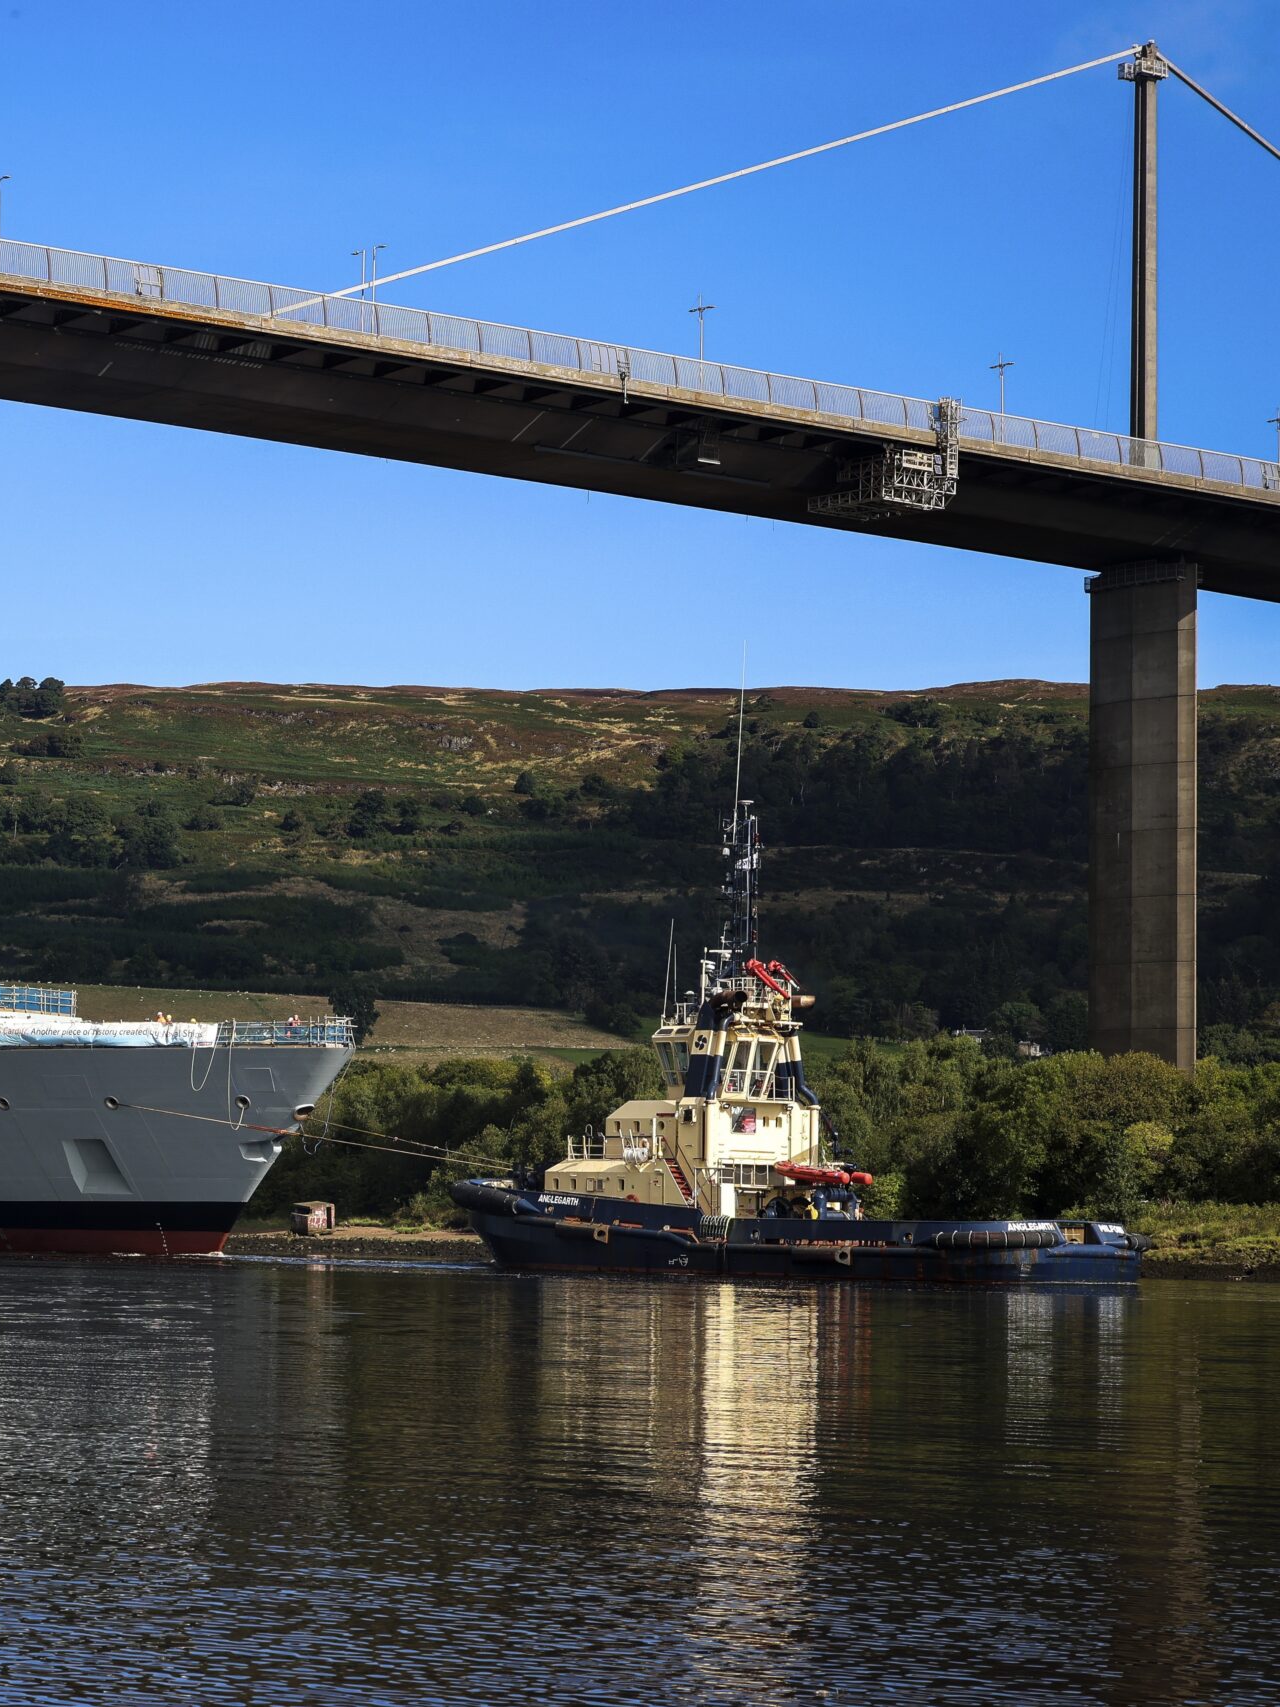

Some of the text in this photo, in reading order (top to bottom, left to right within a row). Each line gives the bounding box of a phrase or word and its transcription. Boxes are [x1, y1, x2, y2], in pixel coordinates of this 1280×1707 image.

[31, 1027, 60, 1036] Another
[61, 1028, 81, 1038] piece
[119, 1027, 147, 1036] created
[537, 1194, 580, 1206] ANGLEGARTH
[1007, 1222, 1056, 1232] ANGLEGARTH
